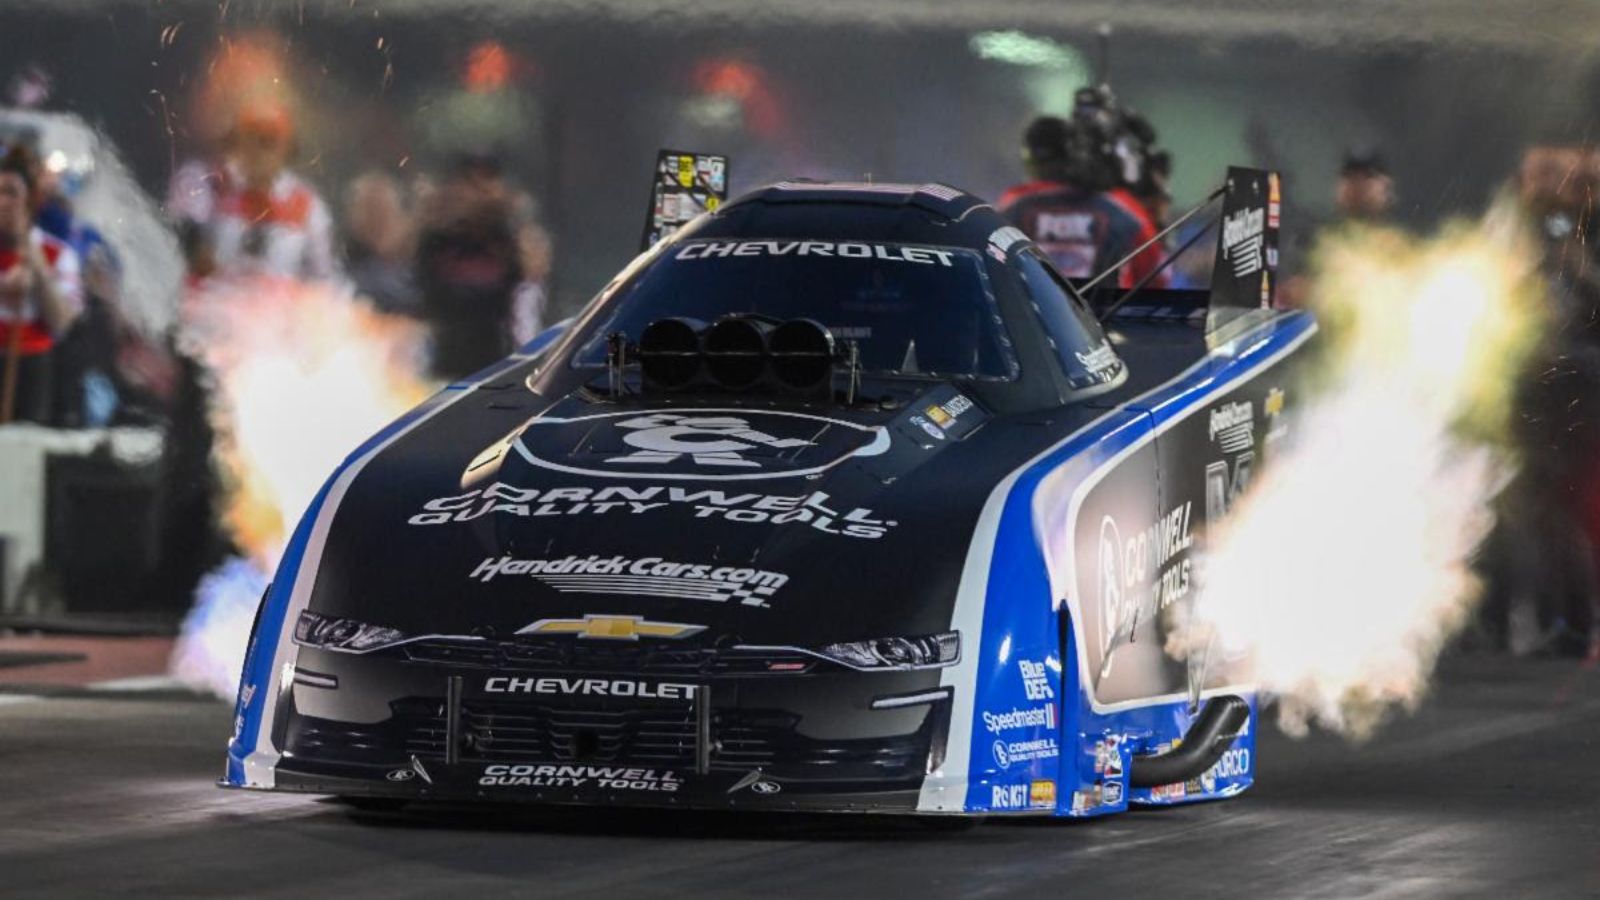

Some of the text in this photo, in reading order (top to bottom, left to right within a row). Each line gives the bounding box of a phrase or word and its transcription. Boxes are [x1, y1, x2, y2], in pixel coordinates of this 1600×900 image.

[674, 241, 955, 267] CHEVROLET
[423, 482, 885, 525] CORNWELL
[408, 499, 888, 539] QUALITY TOOLS
[1018, 659, 1046, 679] Blue
[484, 677, 698, 700] CHEVROLET
[983, 706, 1047, 735] Speedmaster
[478, 775, 680, 792] QUALITY TOOLS
[484, 764, 680, 782] CORNWELL
